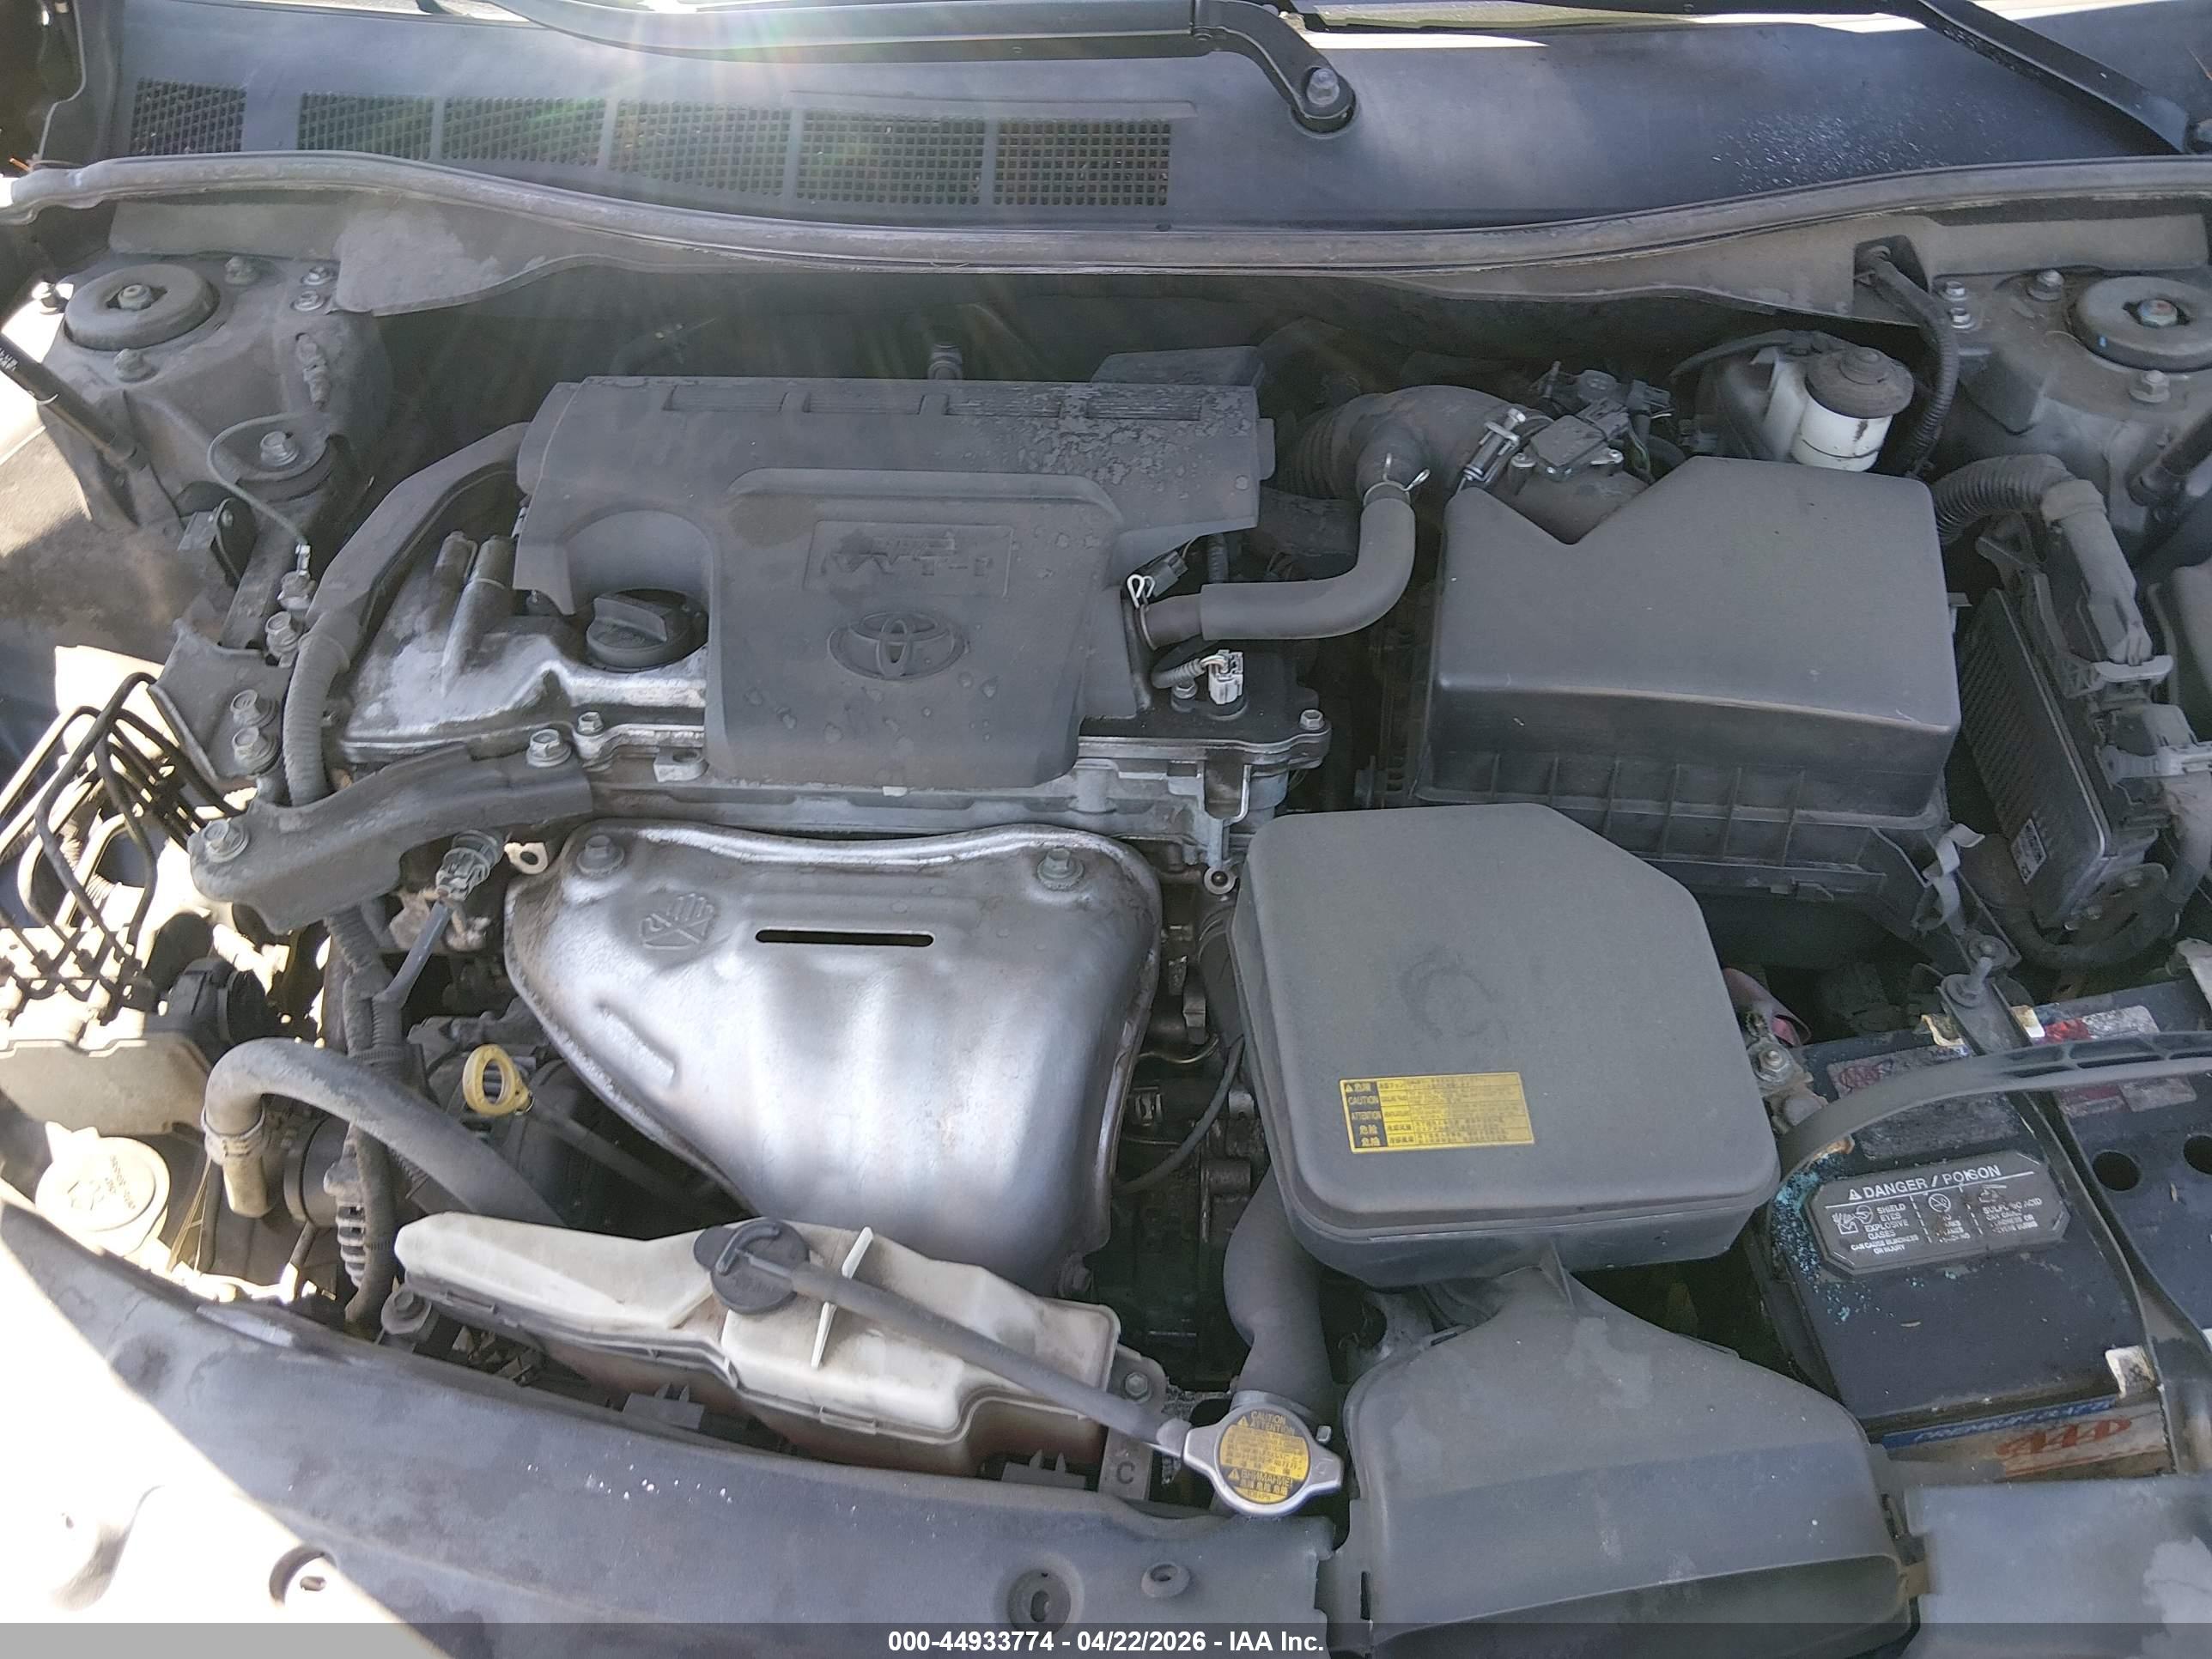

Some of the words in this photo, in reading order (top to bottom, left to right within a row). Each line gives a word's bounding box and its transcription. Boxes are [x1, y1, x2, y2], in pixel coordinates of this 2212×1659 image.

[1347, 1095, 1379, 1105] CAUTION
[1351, 1111, 1382, 1121] ATTENTION
[1862, 1177, 1929, 1199] DANGER
[1942, 1164, 2003, 1186] POISON
[1875, 1203, 1906, 1214] SHIELD
[1880, 1212, 1902, 1222] EYES
[1863, 1219, 1910, 1233] EXPLOSIVE
[1868, 1230, 1896, 1241] GASES
[1250, 1410, 1285, 1424] CAUTION
[1250, 1419, 1295, 1437] ATTENTION
[1115, 1460, 1135, 1485] C
